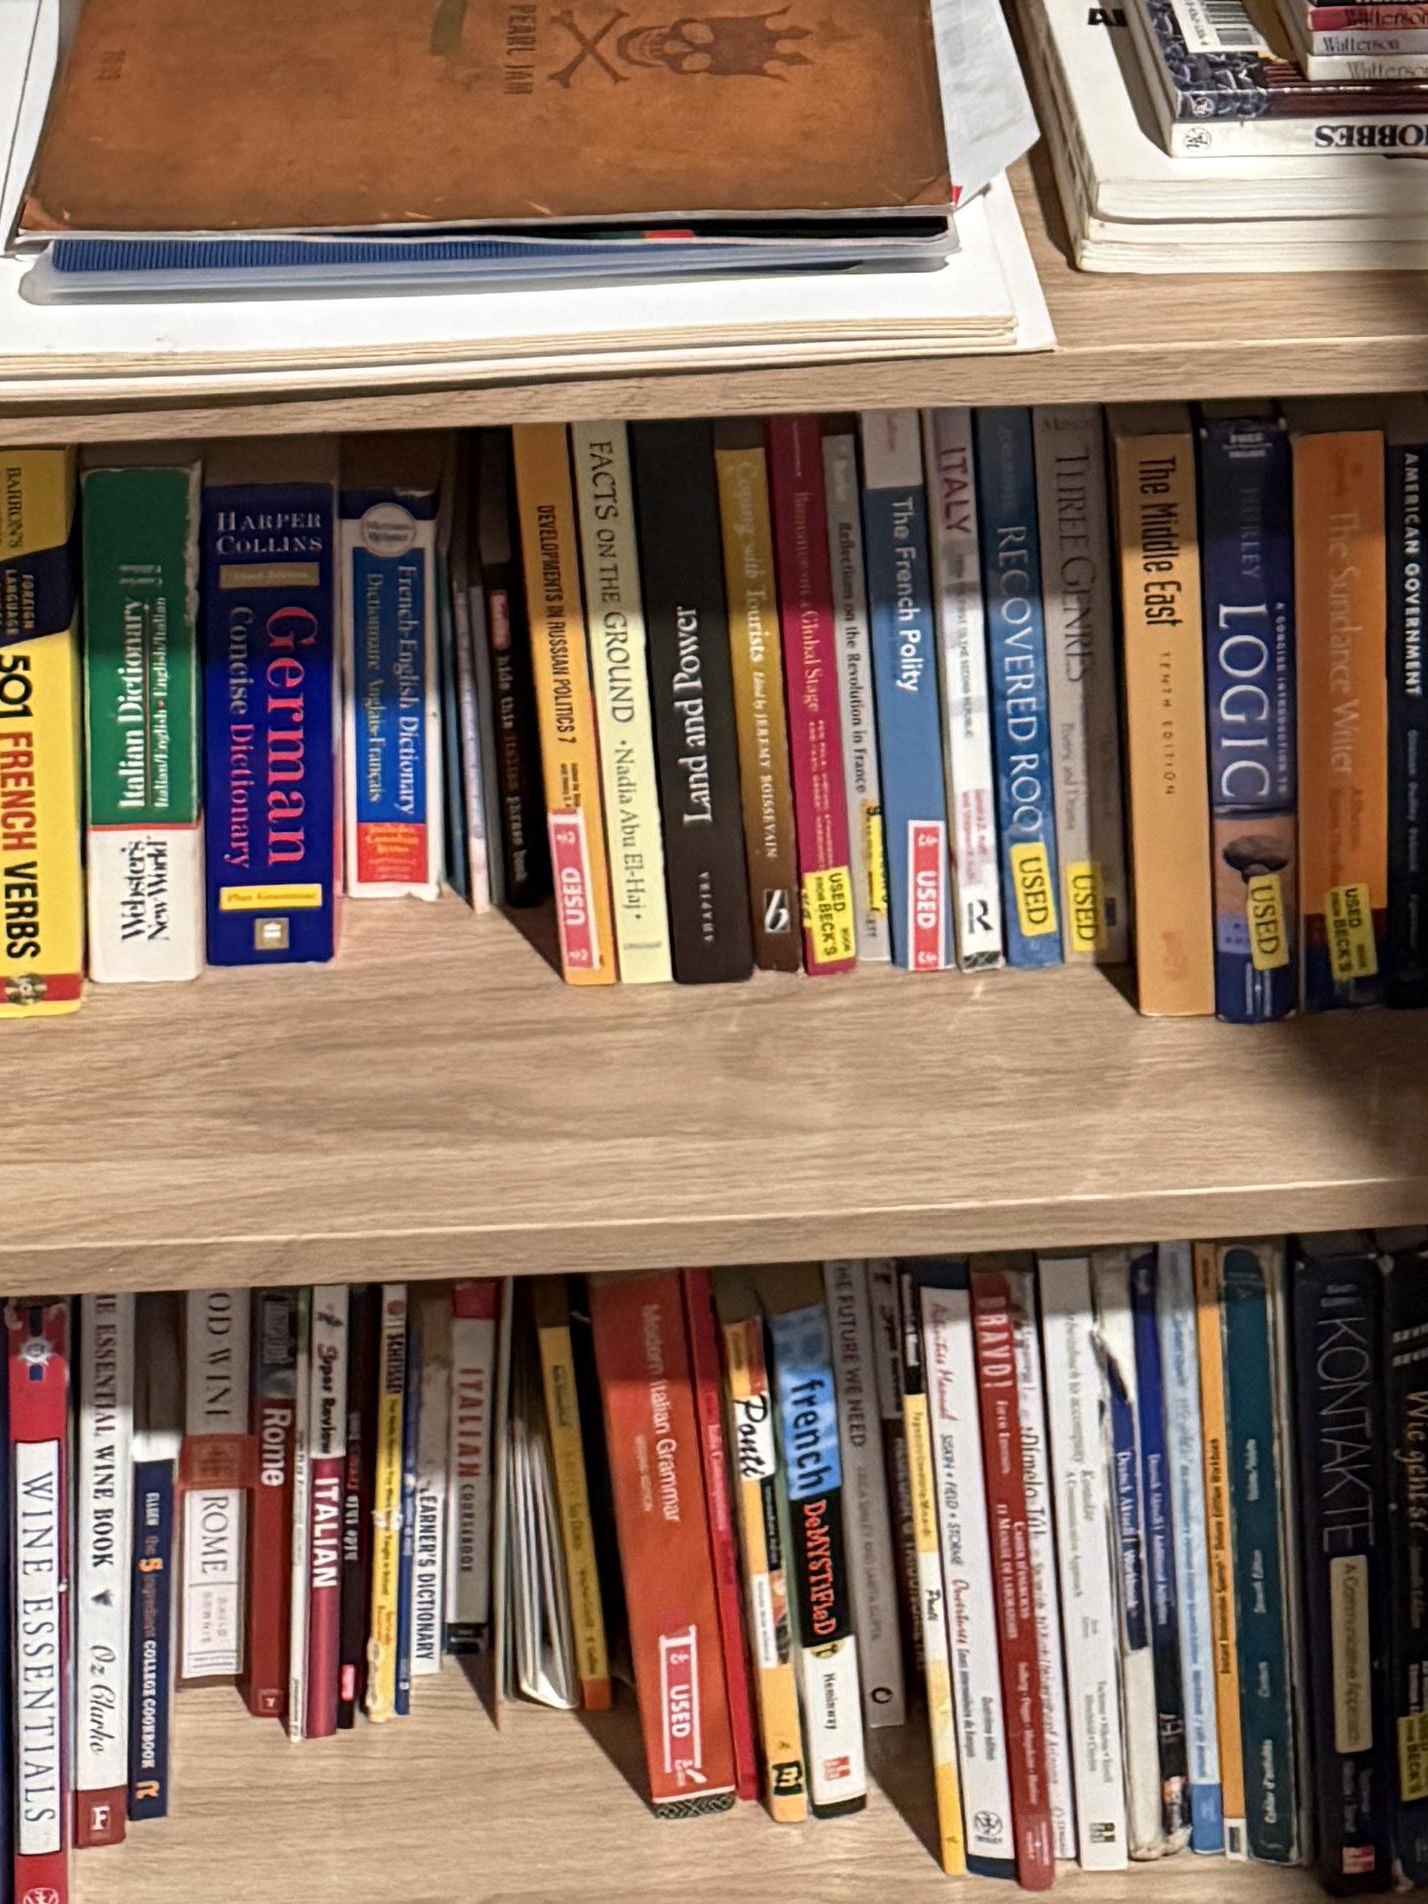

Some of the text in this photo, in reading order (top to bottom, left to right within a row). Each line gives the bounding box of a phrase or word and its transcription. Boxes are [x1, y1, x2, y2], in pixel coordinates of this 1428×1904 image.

[265, 603, 320, 868] German
[673, 604, 713, 827] Land and Power
[995, 525, 1039, 745] RECOVERED
[1217, 601, 1270, 799] LOGIC
[3, 860, 41, 961] VERBS
[791, 1377, 827, 1495] french
[19, 1468, 63, 1826] WINE ESSENTIALS
